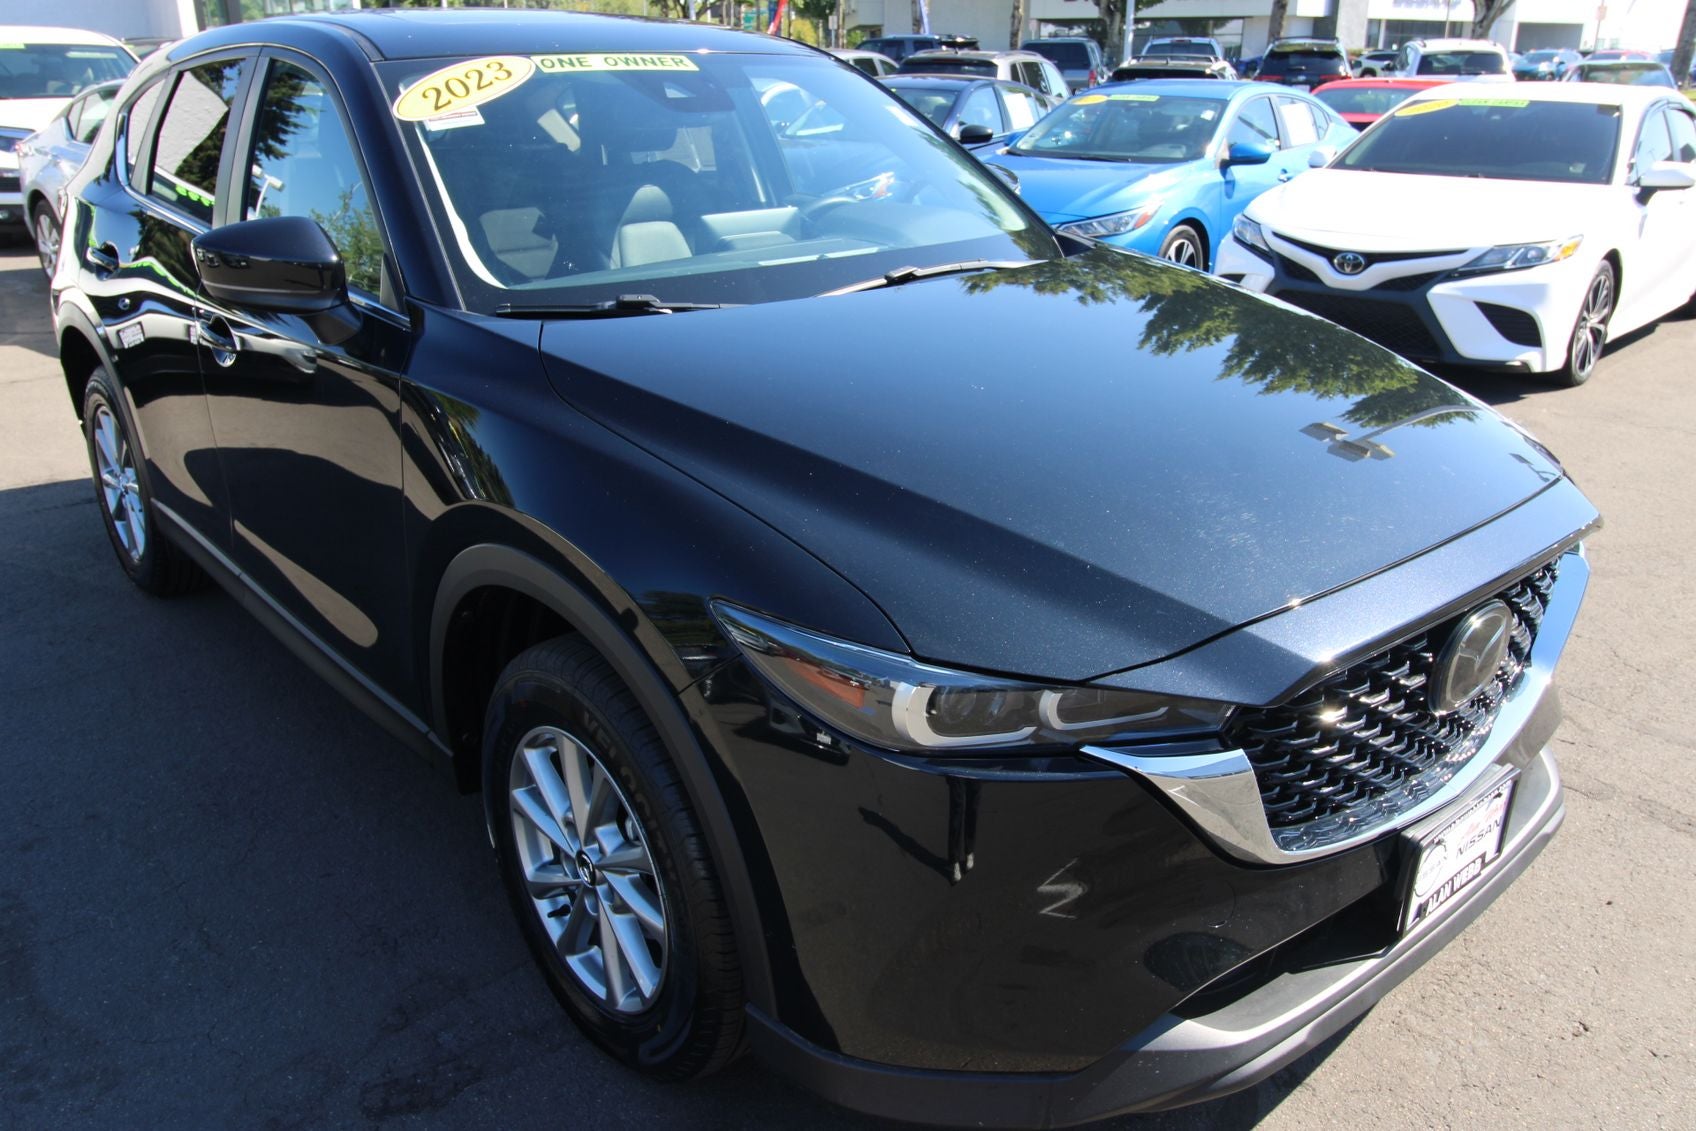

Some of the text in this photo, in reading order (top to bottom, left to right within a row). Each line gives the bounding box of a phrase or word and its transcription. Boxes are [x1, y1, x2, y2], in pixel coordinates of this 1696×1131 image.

[540, 56, 689, 69] ONE OWNER
[422, 61, 513, 112] 2023
[1457, 819, 1500, 855] NISSAN
[1426, 881, 1452, 916] ALAN
